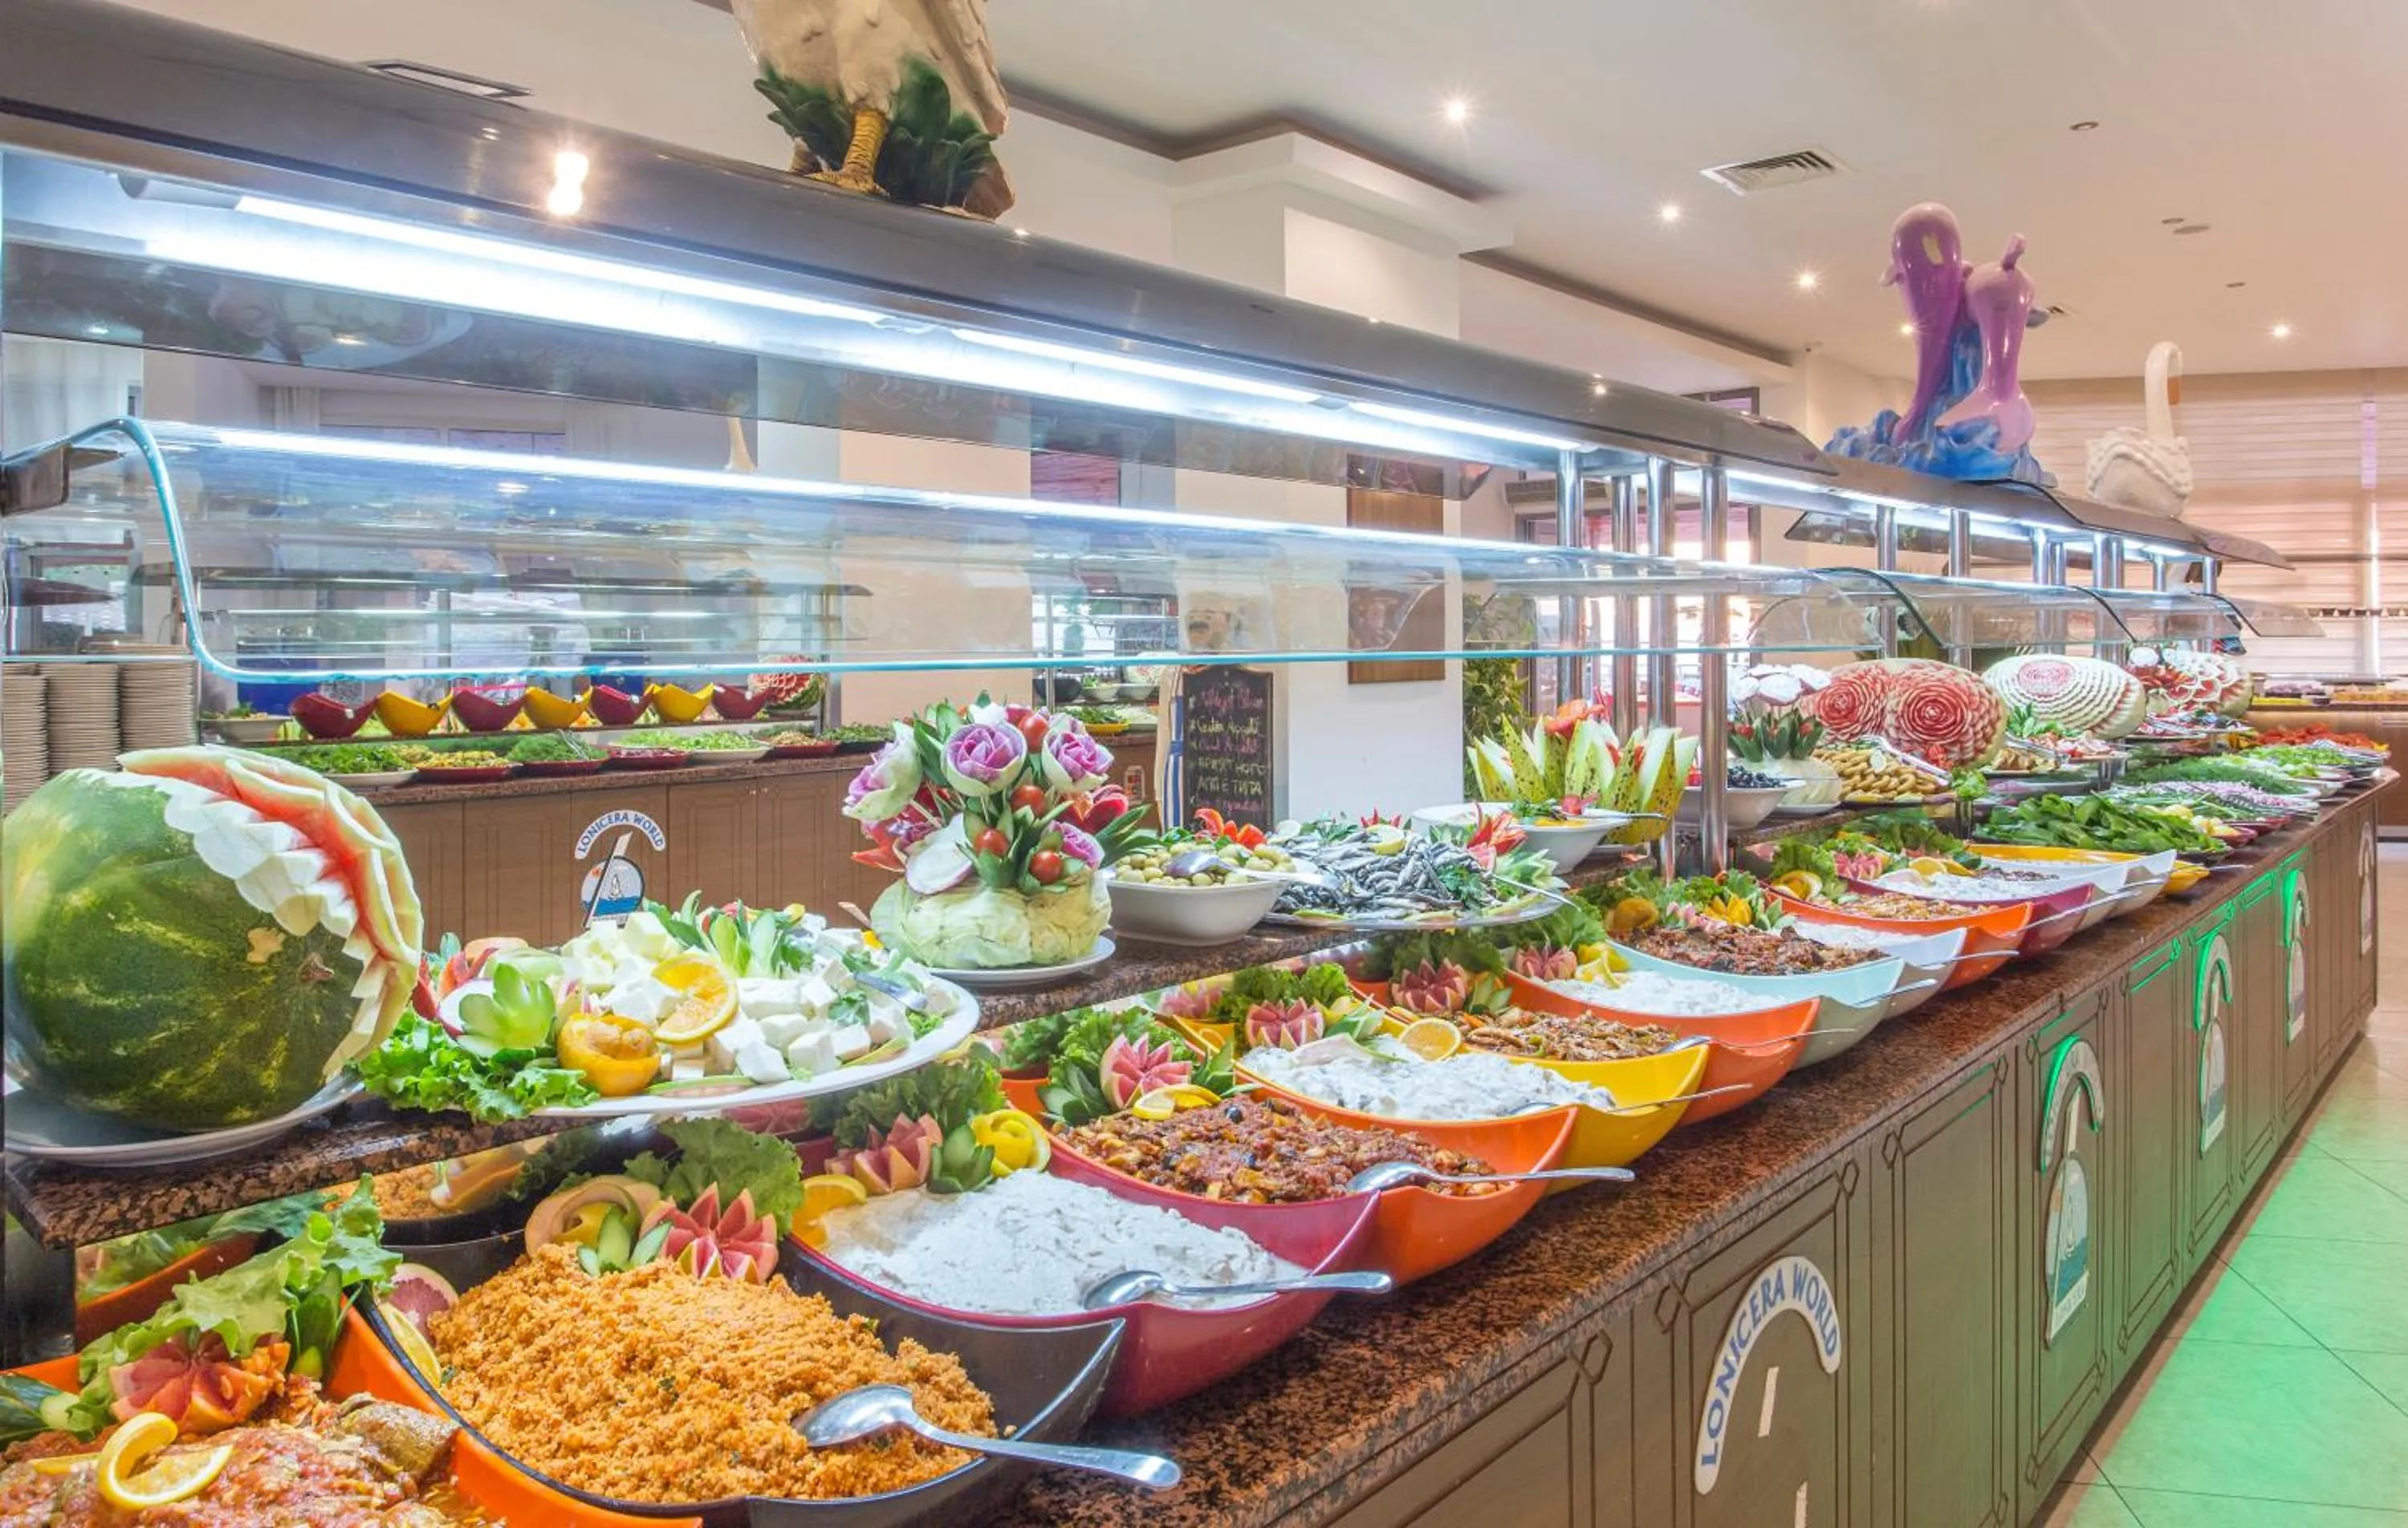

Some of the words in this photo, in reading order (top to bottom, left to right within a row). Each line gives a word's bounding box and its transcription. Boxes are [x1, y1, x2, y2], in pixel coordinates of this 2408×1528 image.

[577, 812, 629, 853] LONICERA
[633, 813, 664, 848] WORLD
[1701, 1266, 1786, 1467] LONICERA
[1792, 1262, 1838, 1357] WORLD
